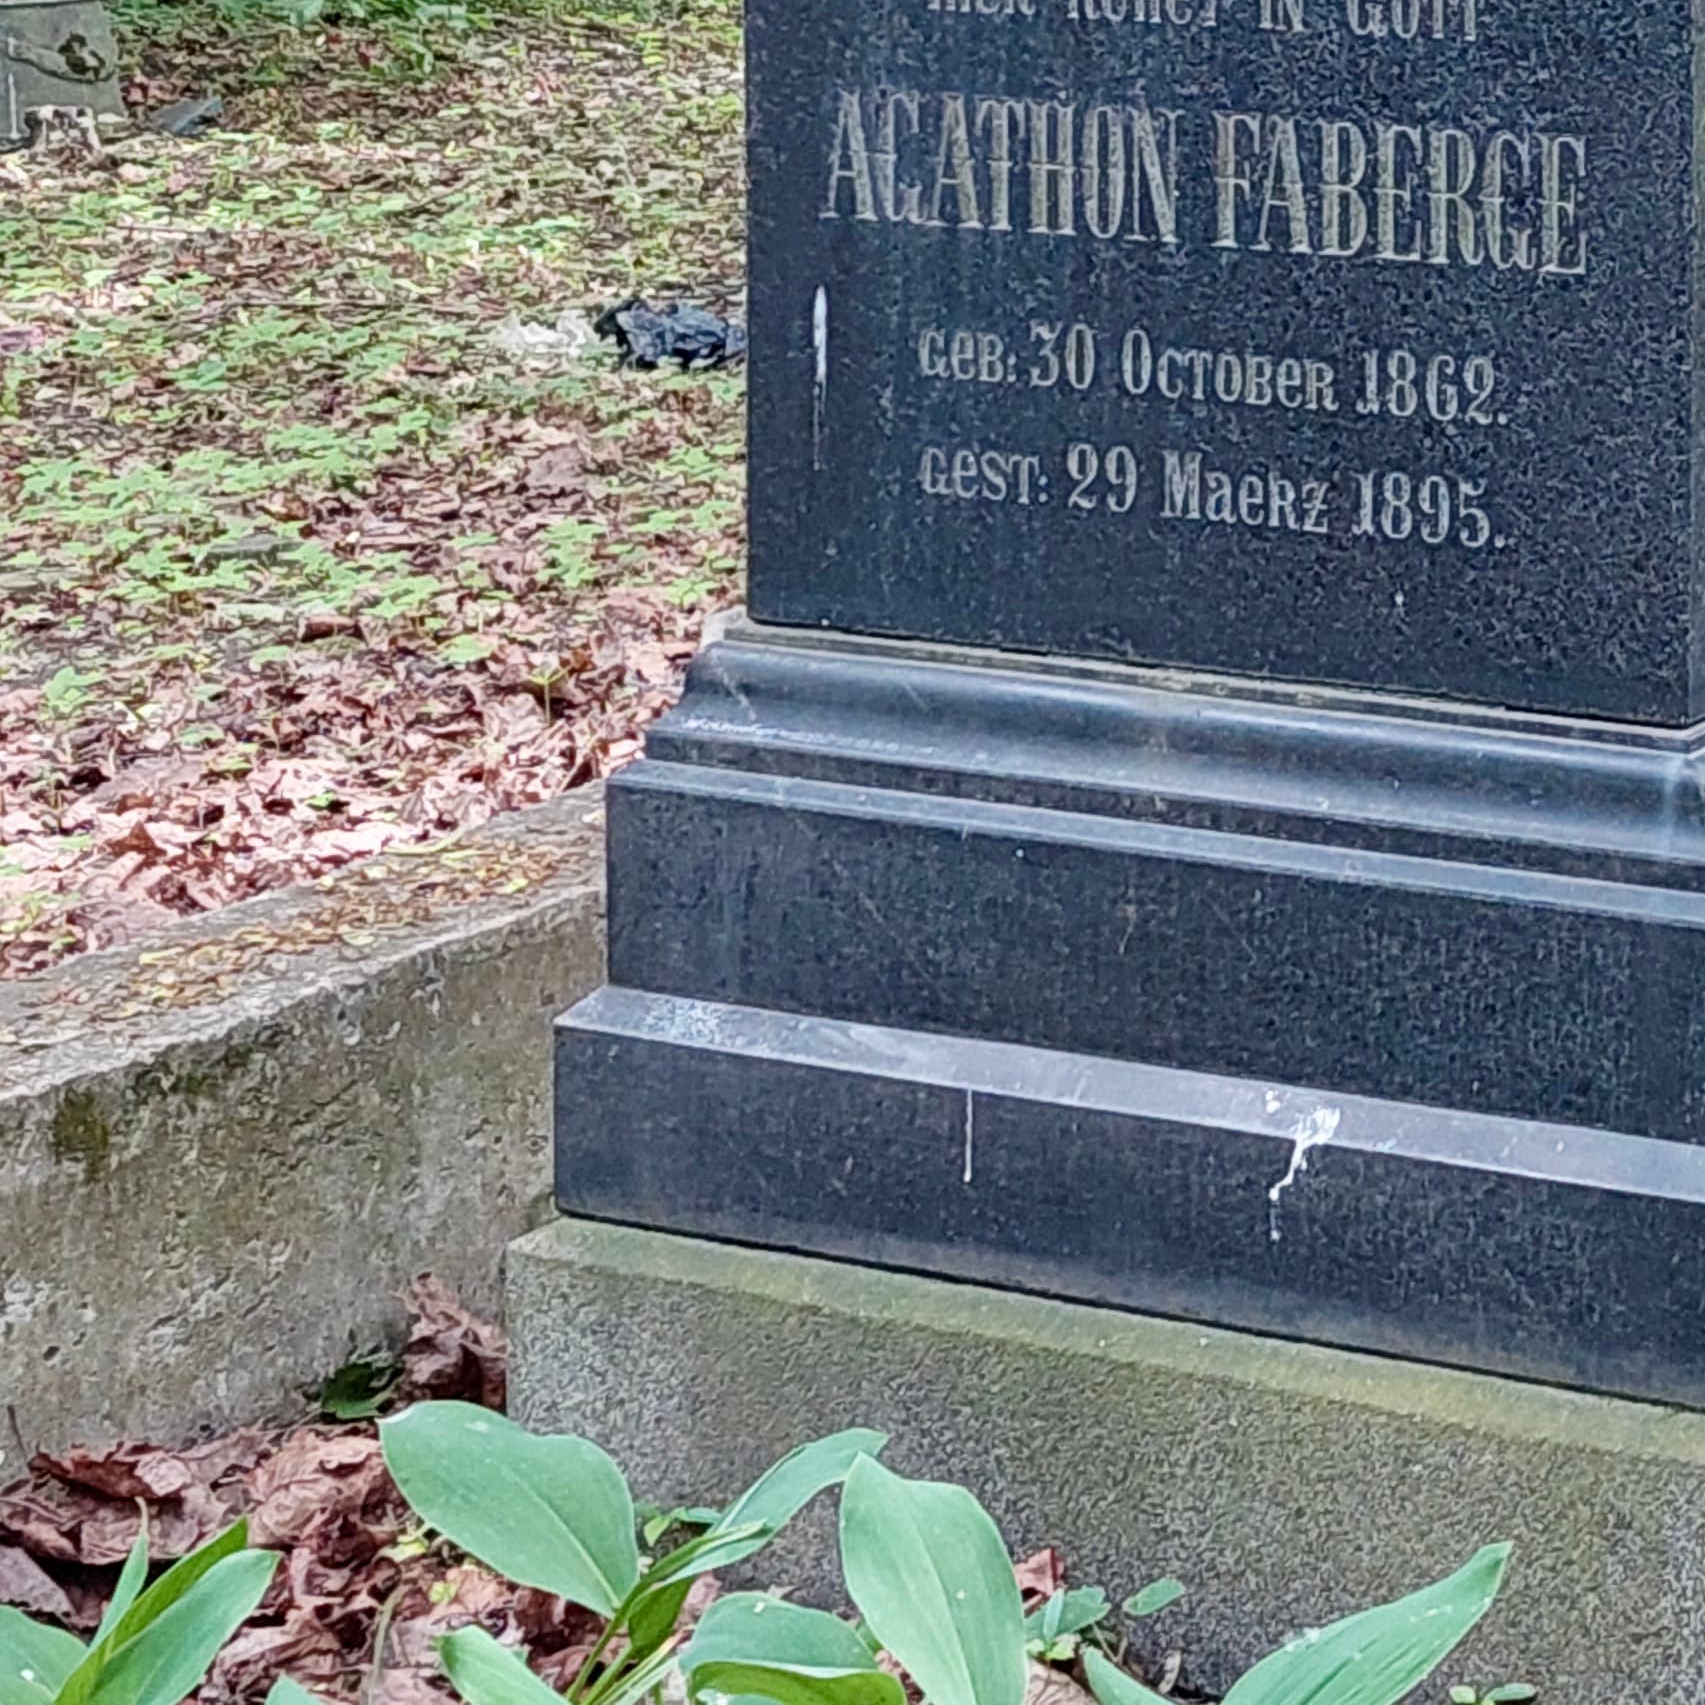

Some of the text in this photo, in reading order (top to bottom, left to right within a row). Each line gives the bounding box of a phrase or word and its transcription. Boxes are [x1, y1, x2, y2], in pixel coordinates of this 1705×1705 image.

[819, 88, 1589, 275] AGATHON FABERGE
[1030, 322, 1096, 390] 30
[1065, 442, 1138, 513] 29
[1351, 468, 1507, 549] 1895.
